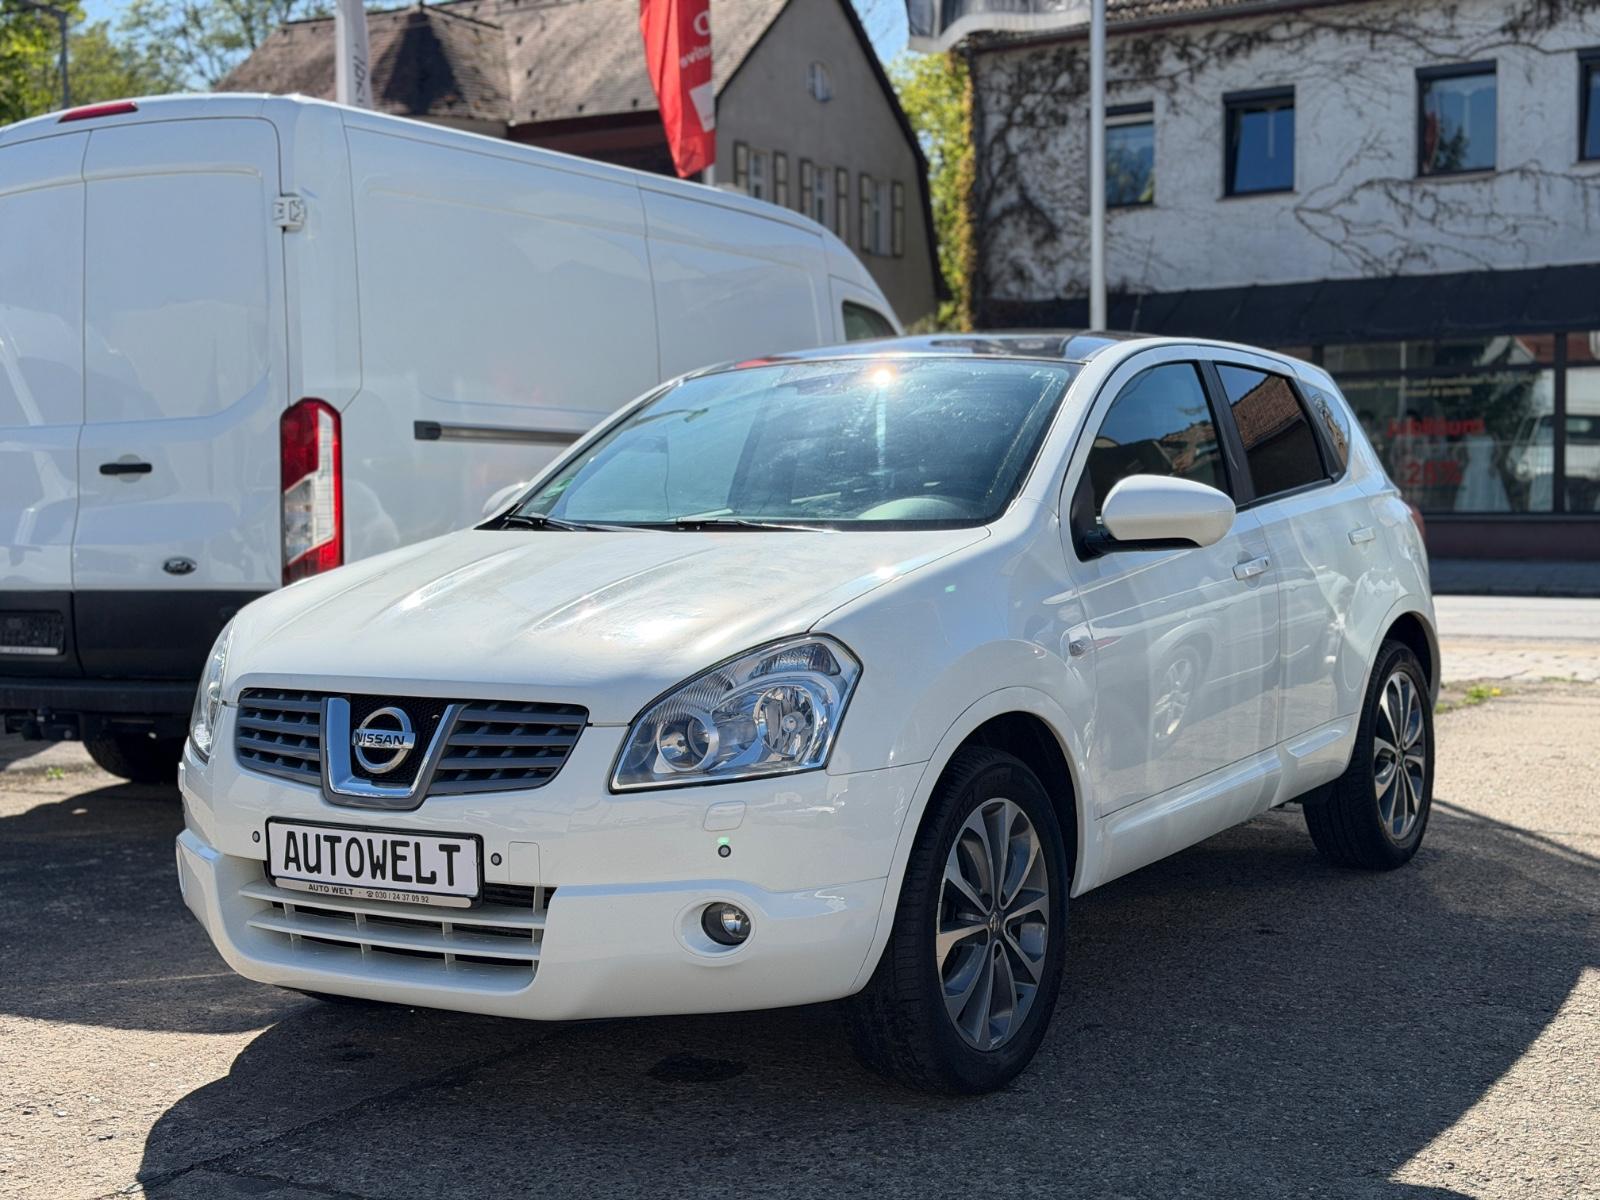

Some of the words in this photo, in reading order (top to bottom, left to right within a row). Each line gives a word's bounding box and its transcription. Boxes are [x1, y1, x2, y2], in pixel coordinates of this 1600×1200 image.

[355, 732, 405, 745] NISSAN
[283, 830, 461, 887] AUTOWELT
[308, 883, 330, 893] AUTO
[331, 886, 354, 896] WELT
[375, 890, 387, 900] 030
[392, 892, 401, 901] 24
